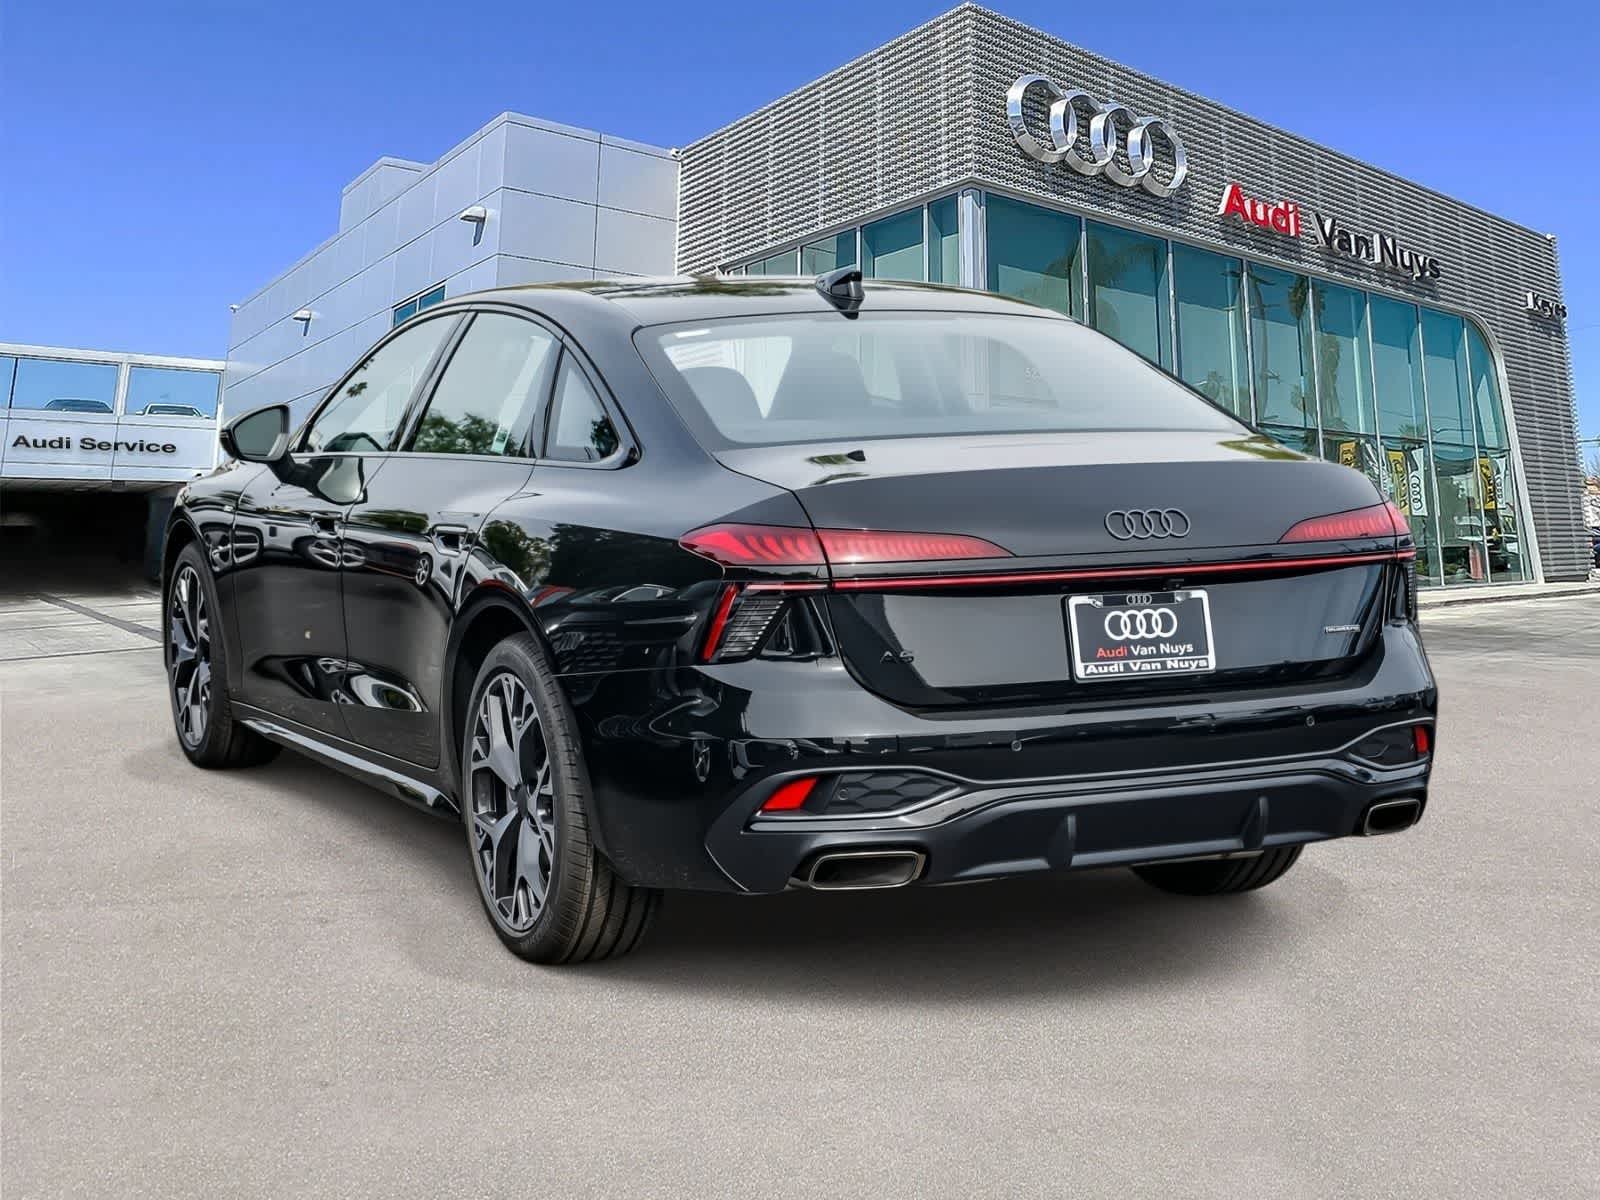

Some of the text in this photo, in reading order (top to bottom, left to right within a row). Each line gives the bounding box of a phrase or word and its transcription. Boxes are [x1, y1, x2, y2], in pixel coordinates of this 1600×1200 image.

[1217, 182, 1441, 280] Audi Van Nuys
[1526, 291, 1568, 319] Keyes
[12, 435, 177, 454] Audi Service
[1096, 642, 1194, 659] Audi Van Nuys
[1085, 658, 1208, 675] Audi Van Nuys
